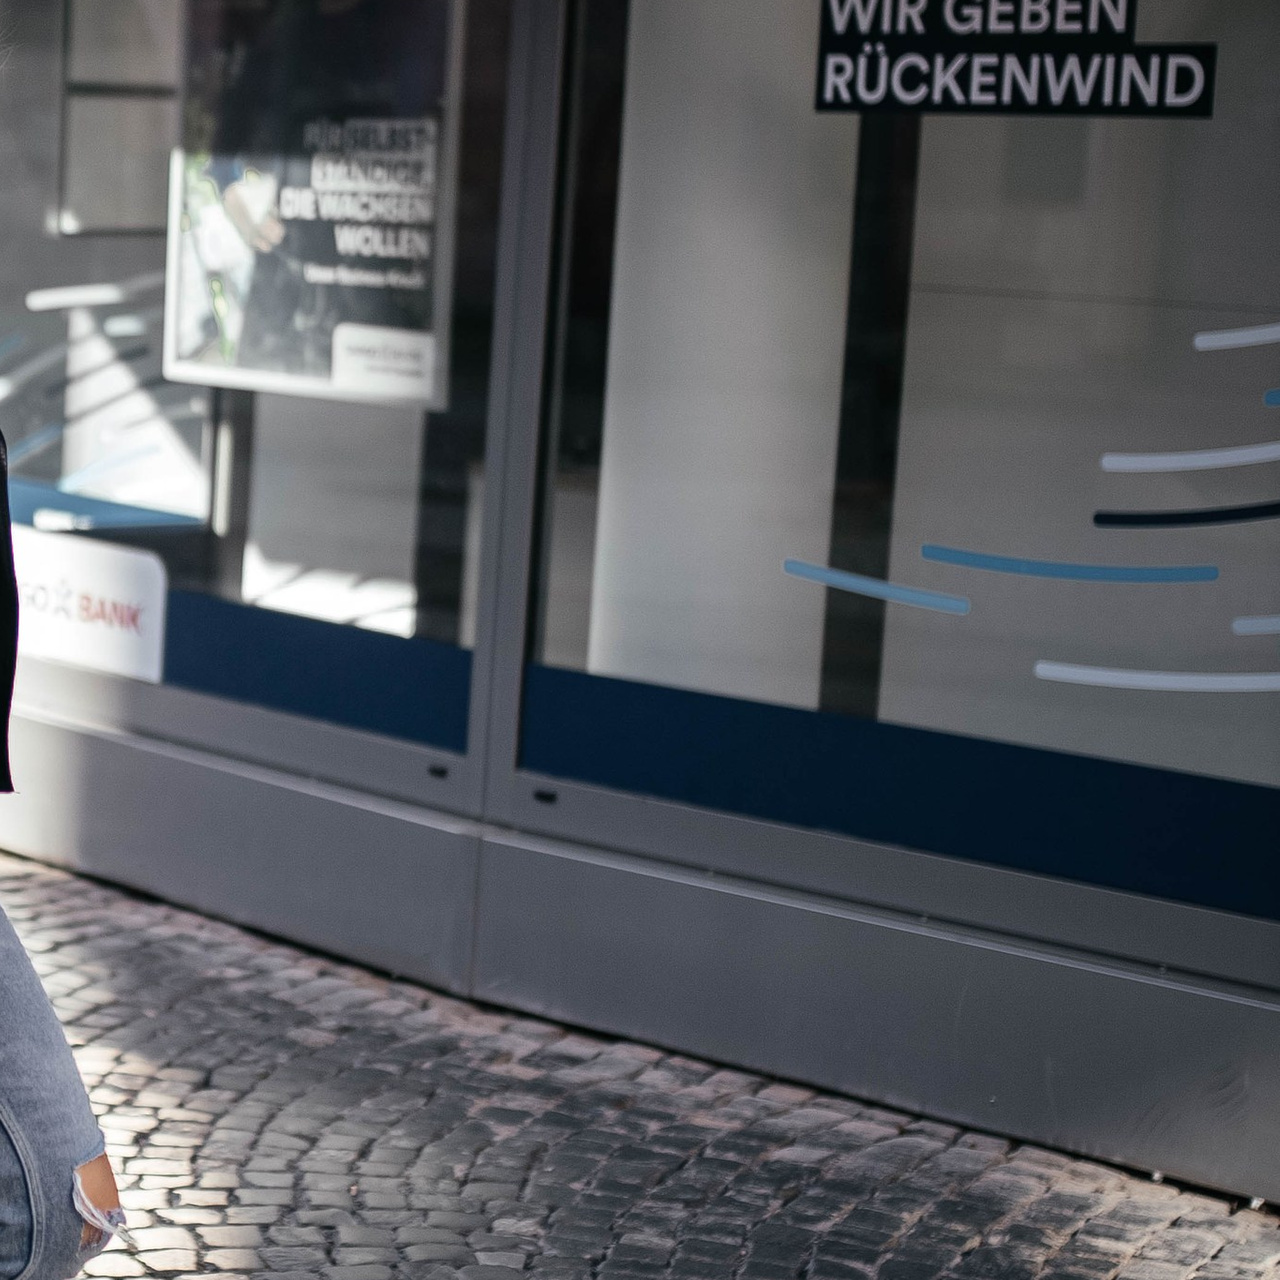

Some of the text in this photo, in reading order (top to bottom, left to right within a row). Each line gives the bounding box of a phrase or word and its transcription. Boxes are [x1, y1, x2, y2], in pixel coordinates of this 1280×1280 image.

[823, 42, 1206, 107] RÜCKENWIND
[318, 191, 434, 223] WACHSEN
[334, 224, 431, 259] WOLLEN
[77, 593, 144, 635] BANK
